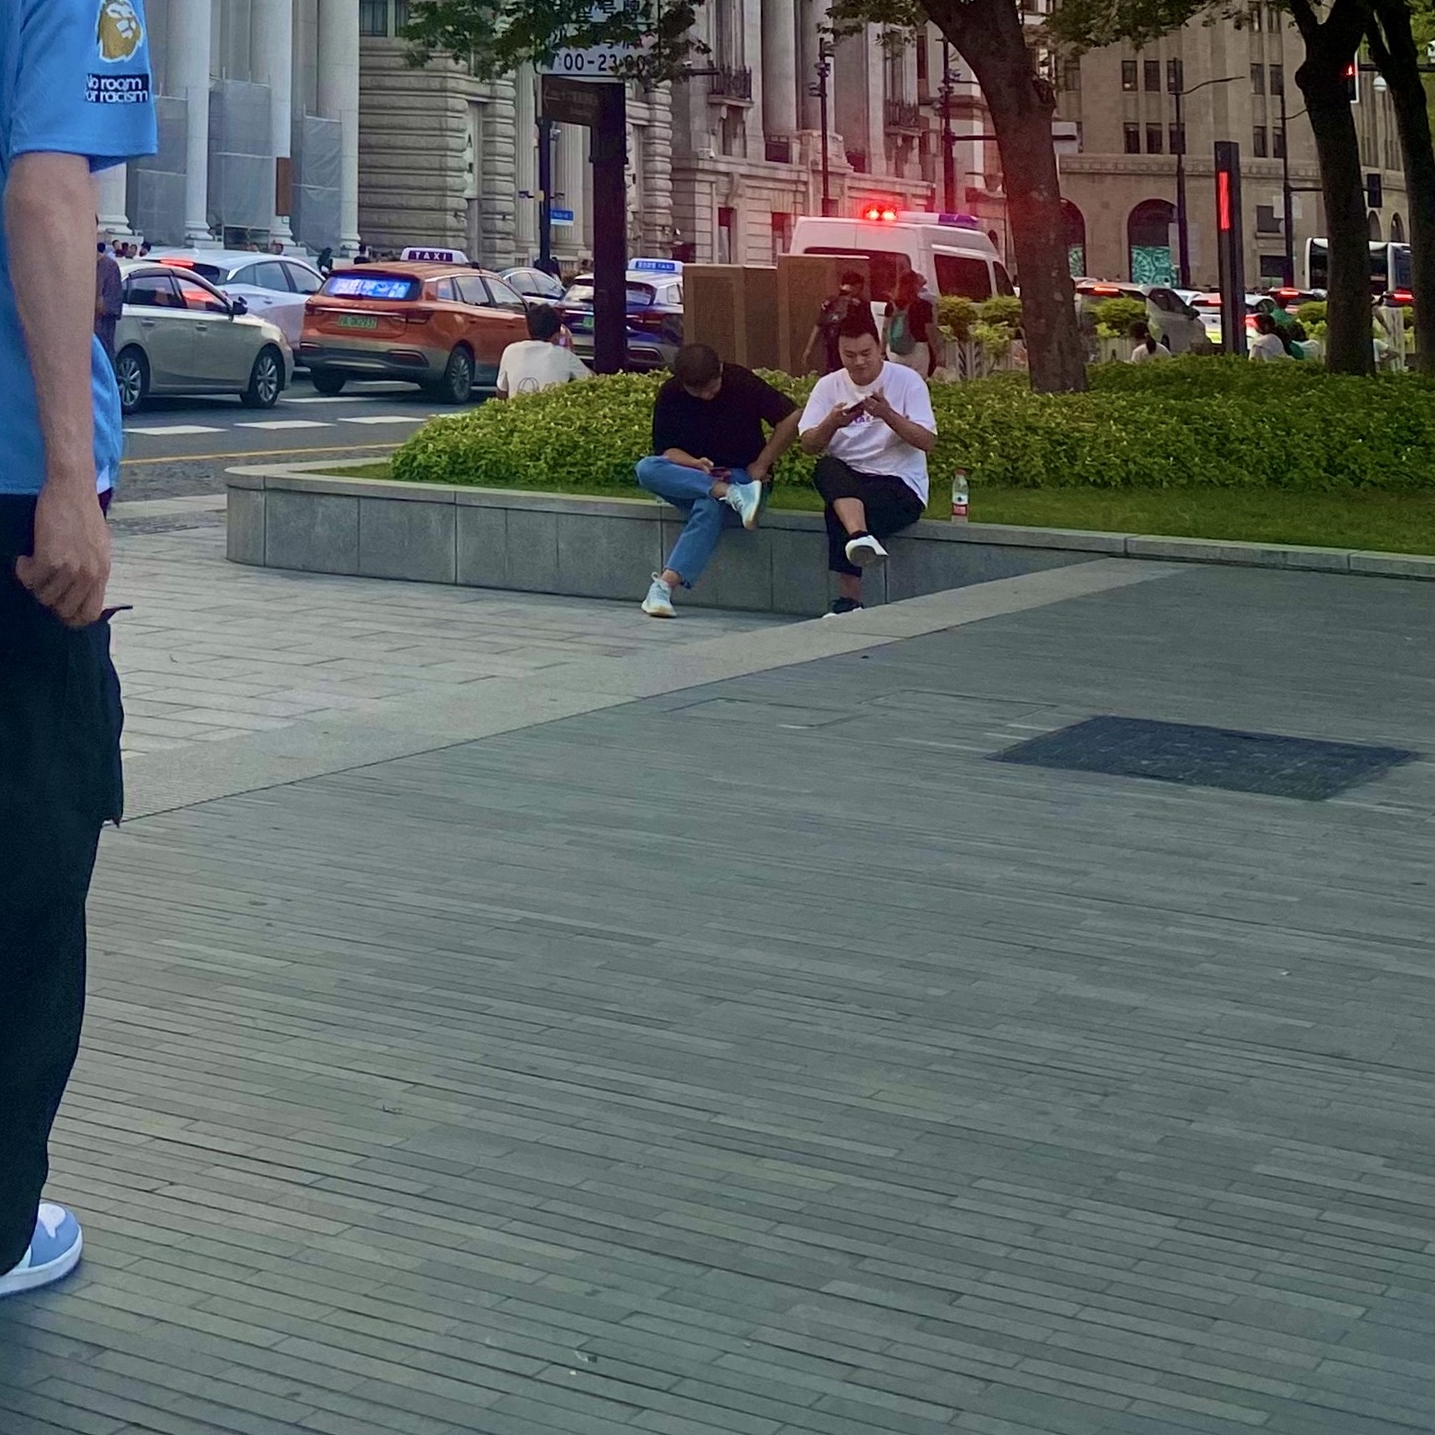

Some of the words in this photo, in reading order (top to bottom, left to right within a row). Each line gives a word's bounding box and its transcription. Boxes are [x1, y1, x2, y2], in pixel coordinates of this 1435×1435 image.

[100, 77, 143, 91] room
[99, 90, 148, 103] racism
[415, 251, 447, 261] TAXI
